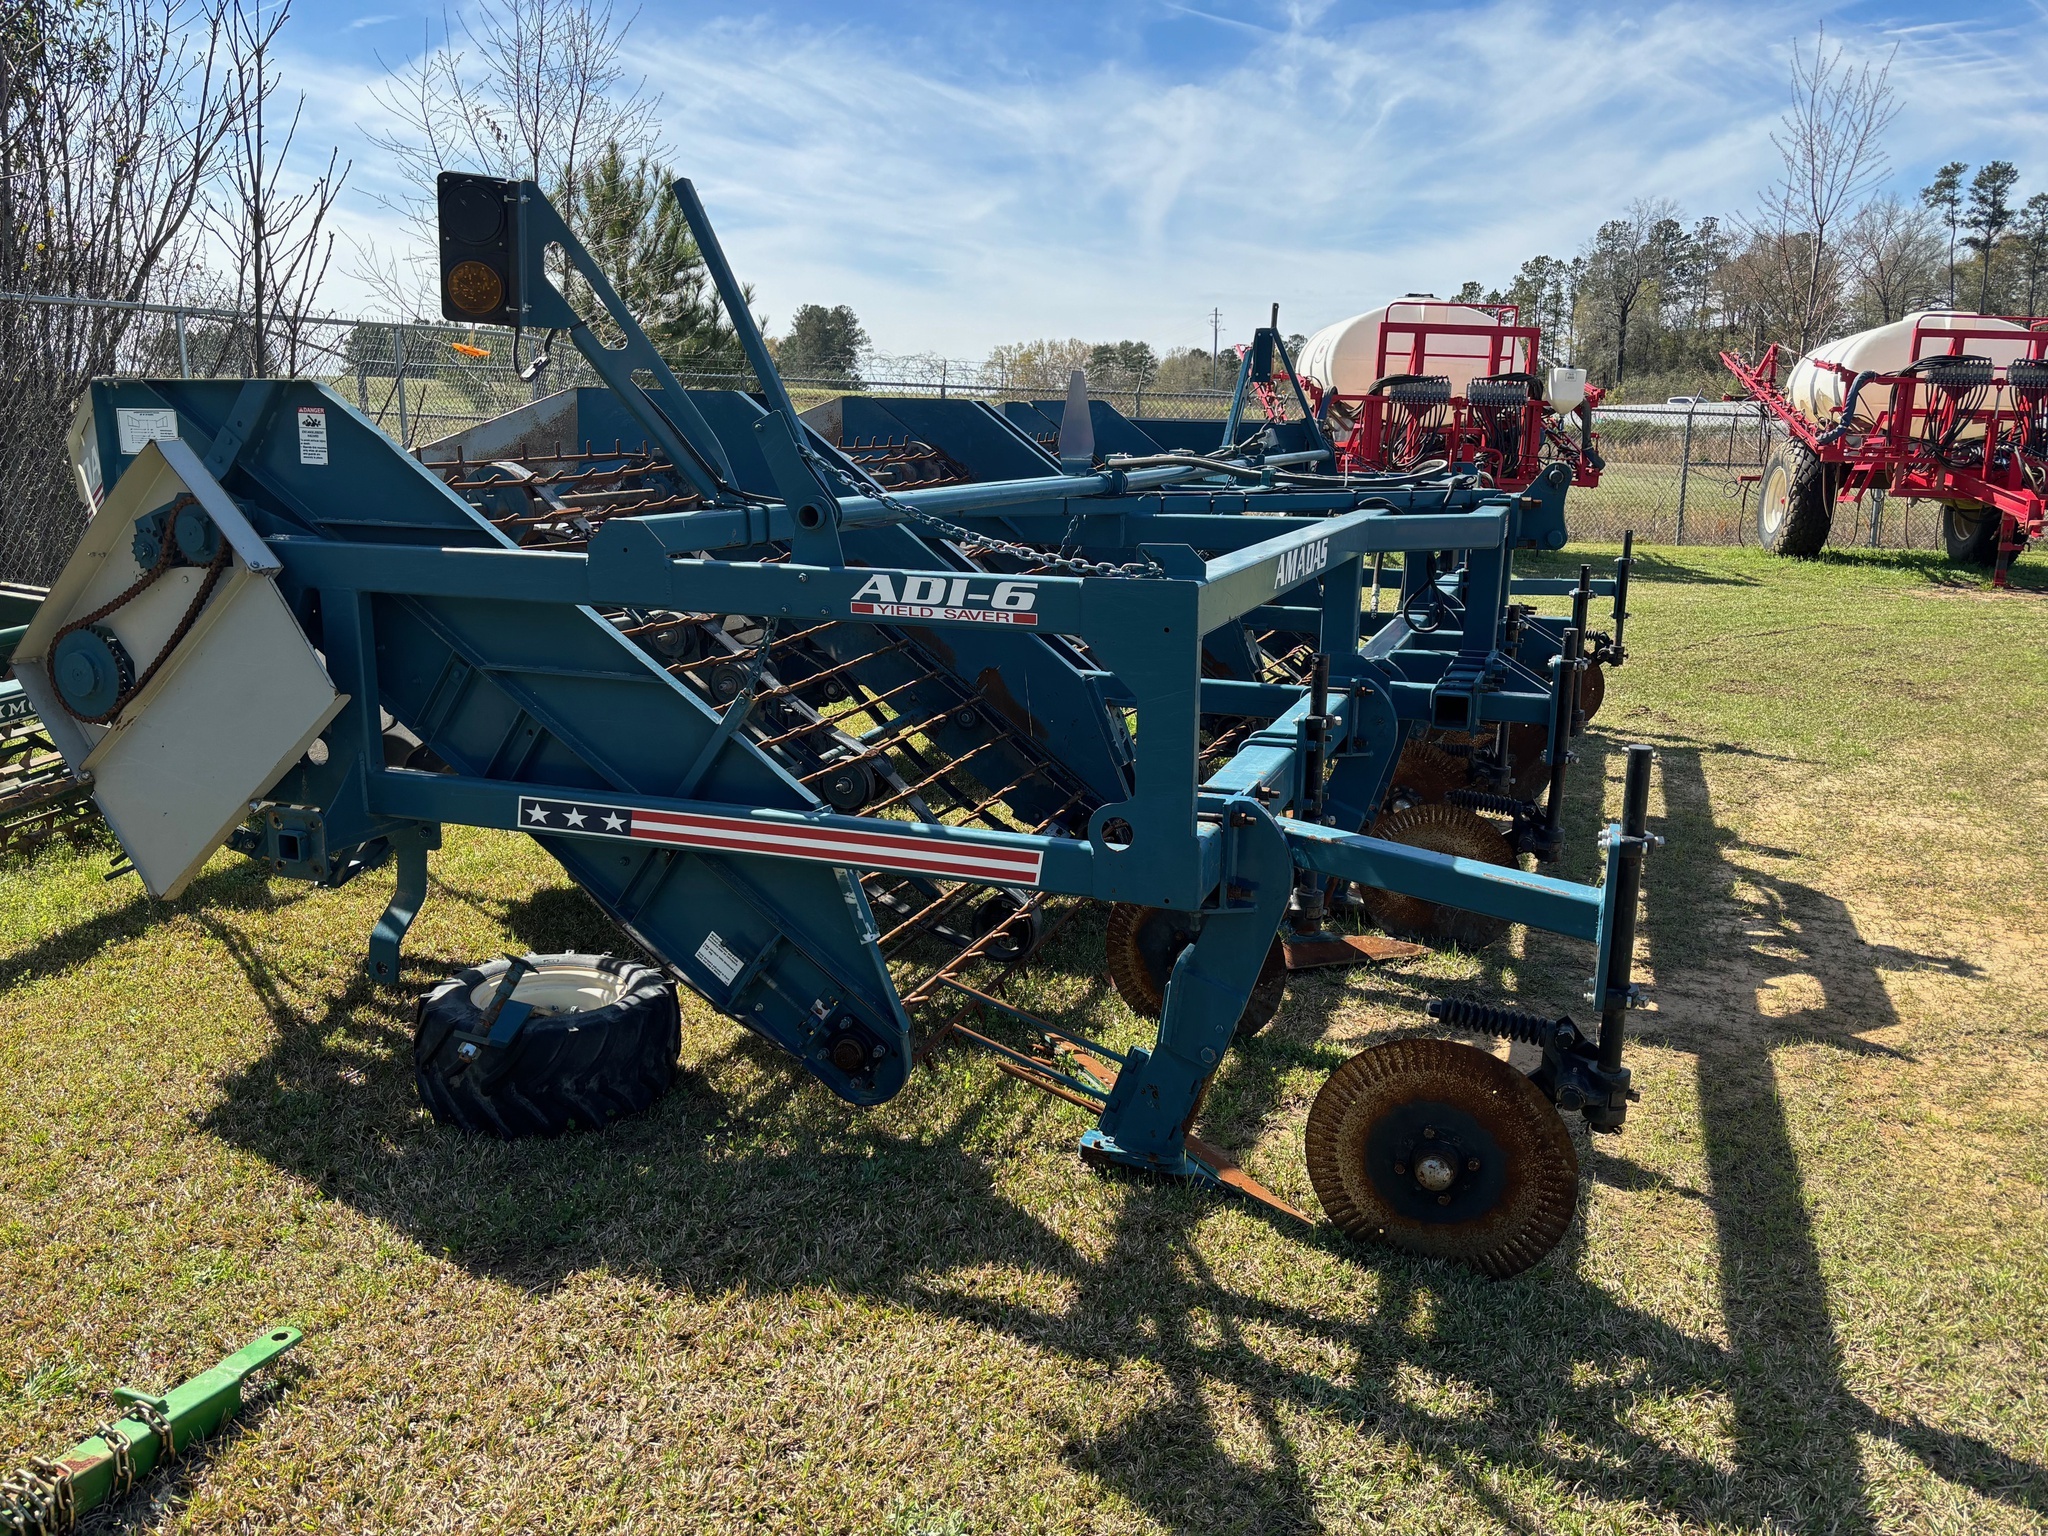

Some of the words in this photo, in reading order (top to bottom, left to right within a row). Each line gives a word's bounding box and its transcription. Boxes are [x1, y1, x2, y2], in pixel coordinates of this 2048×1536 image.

[1273, 538, 1329, 590] AMADAS
[851, 574, 1039, 611] ADI-6
[877, 605, 934, 618] YIELD
[944, 609, 1010, 623] SAVER
